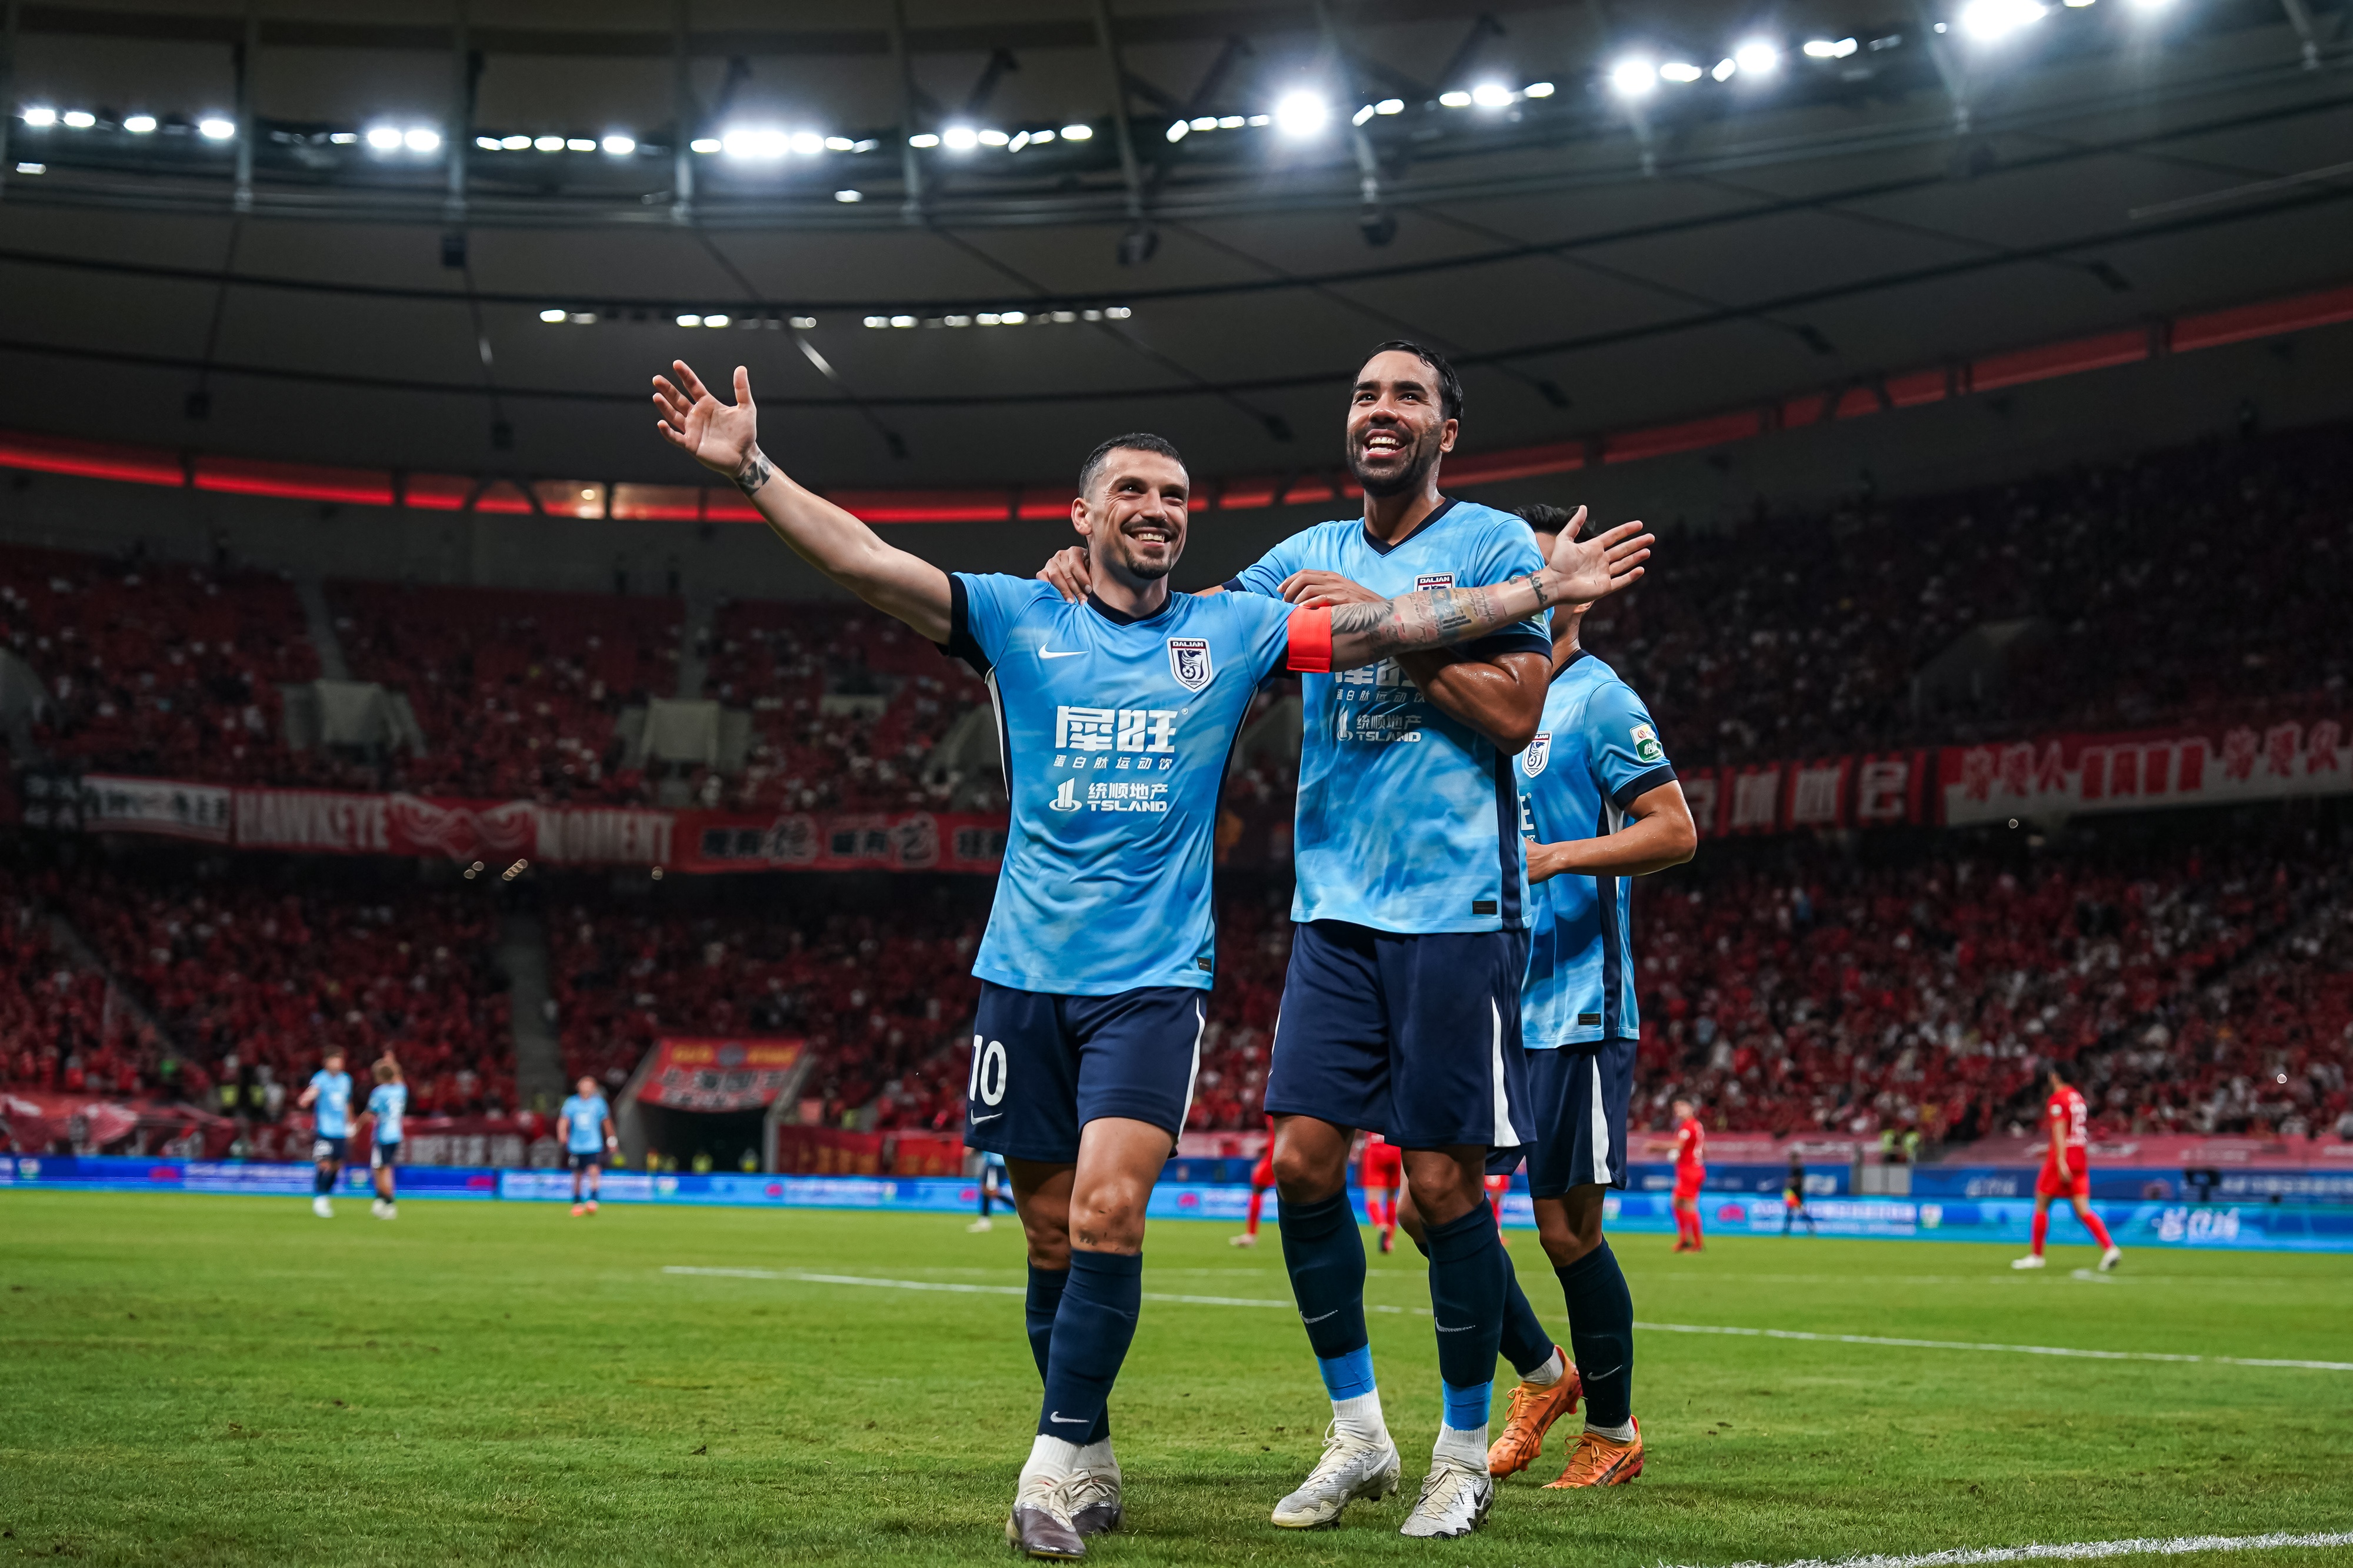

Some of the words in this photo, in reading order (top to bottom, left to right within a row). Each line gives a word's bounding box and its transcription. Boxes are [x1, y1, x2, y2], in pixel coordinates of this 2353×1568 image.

[1336, 688, 1426, 703] 蛋白肽运动饮
[1055, 705, 1179, 753] 犀旺
[1356, 714, 1422, 730] 统顺地产
[1356, 731, 1422, 742] TSLAND
[1053, 754, 1173, 770] 蛋白肽运动饮
[1088, 782, 1168, 800] 统顺地产
[1087, 800, 1168, 812] TSLAND
[236, 790, 389, 848] HAWKEYE
[969, 1034, 1007, 1106] 10
